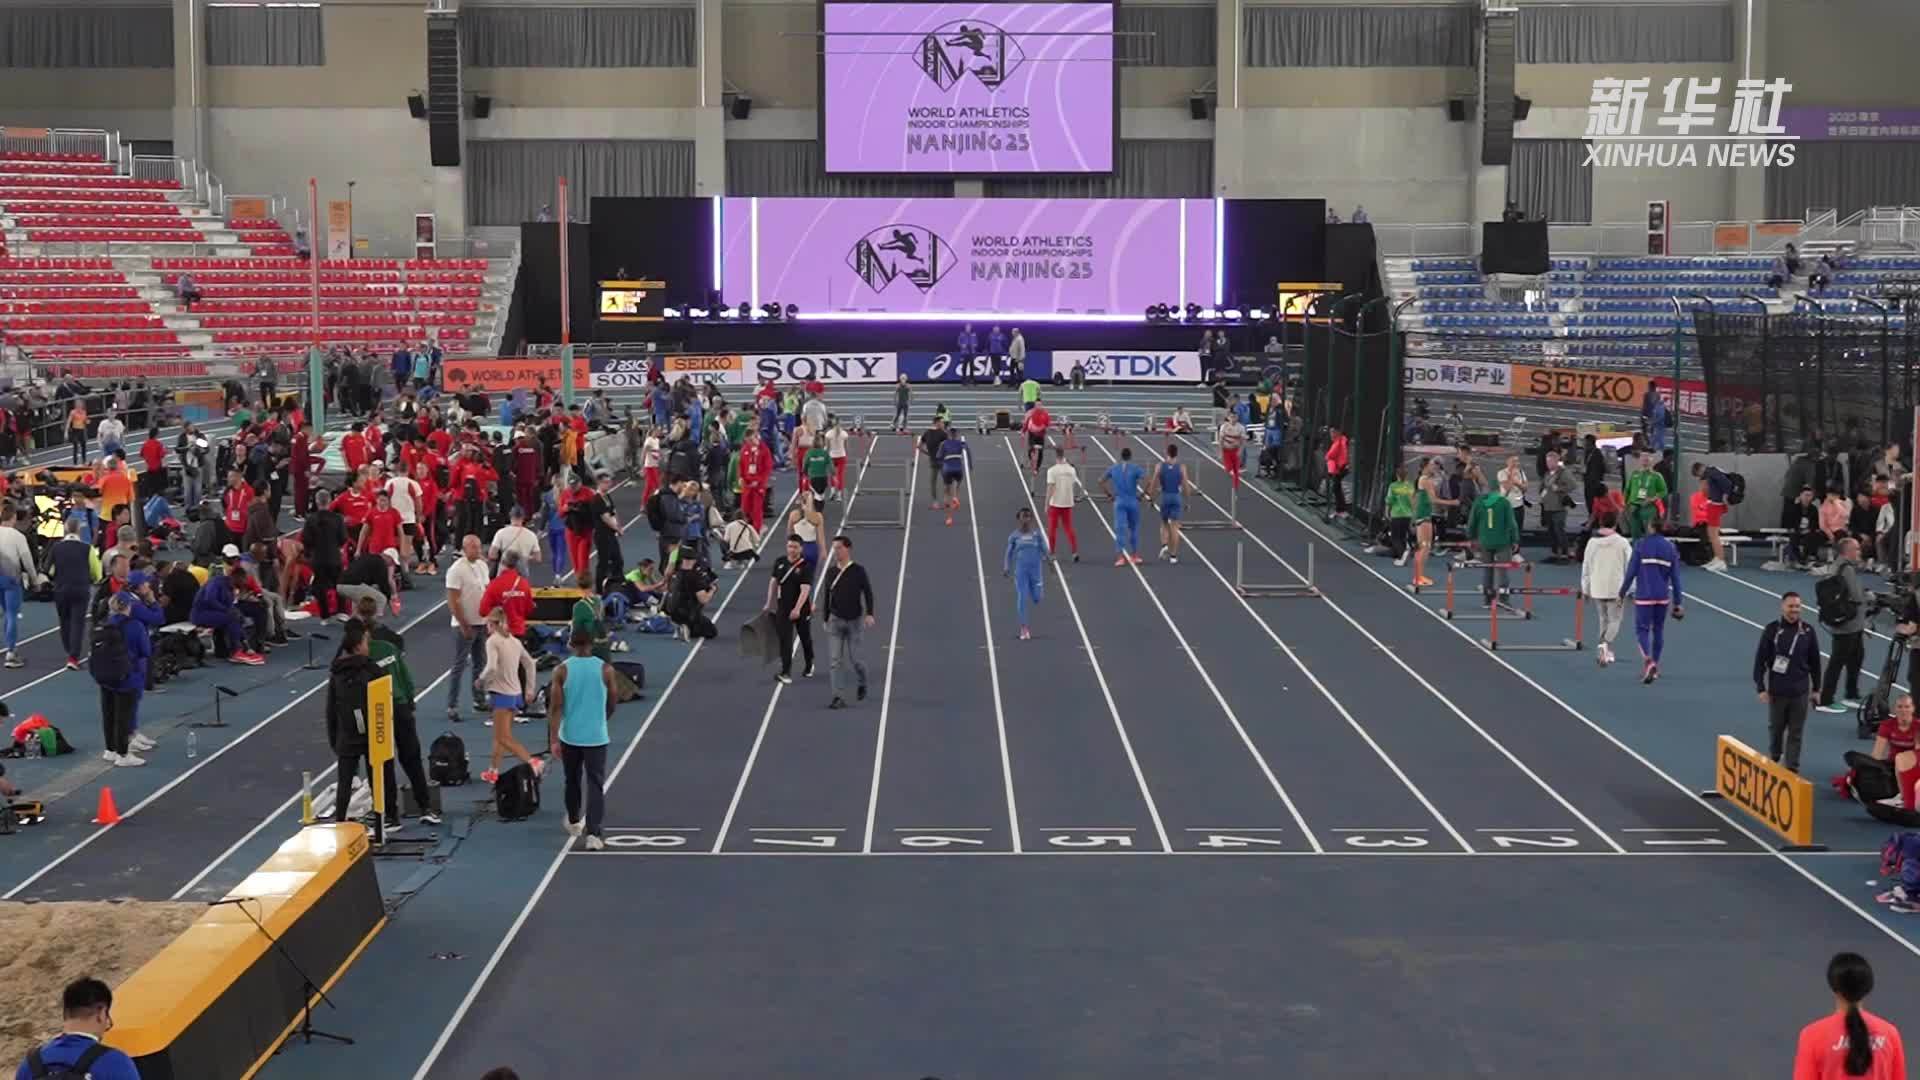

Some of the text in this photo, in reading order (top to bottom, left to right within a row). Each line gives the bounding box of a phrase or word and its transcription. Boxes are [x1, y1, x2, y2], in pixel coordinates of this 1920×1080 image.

[908, 107, 1030, 118] WORLD ATHLETICS
[908, 120, 1030, 129] INDOOR CHAMPIONSHIPS
[907, 131, 1030, 155] NANJING 25
[971, 236, 1093, 247] WORLD ATHLETICS
[971, 249, 1093, 257] INDOOR CHAMPIONSHIPS
[970, 260, 1093, 282] NANJING 25
[674, 357, 732, 371] SEIKO
[756, 356, 884, 381] SONY
[1105, 354, 1177, 377] TDK
[471, 367, 584, 382] WORLD ATHLETS
[596, 374, 643, 387] SON
[691, 373, 727, 385] TDK
[1530, 369, 1634, 402] SEIKO
[1722, 747, 1793, 833] SEIKO
[604, 834, 686, 847] 8
[754, 835, 837, 848] 7
[901, 835, 984, 847] 6
[1049, 835, 1132, 847] 5
[1199, 835, 1281, 848] 4
[1346, 835, 1429, 848] 3
[1493, 835, 1580, 848] 2
[1643, 836, 1728, 845] 1
[1832, 1035, 1887, 1051] JAN
